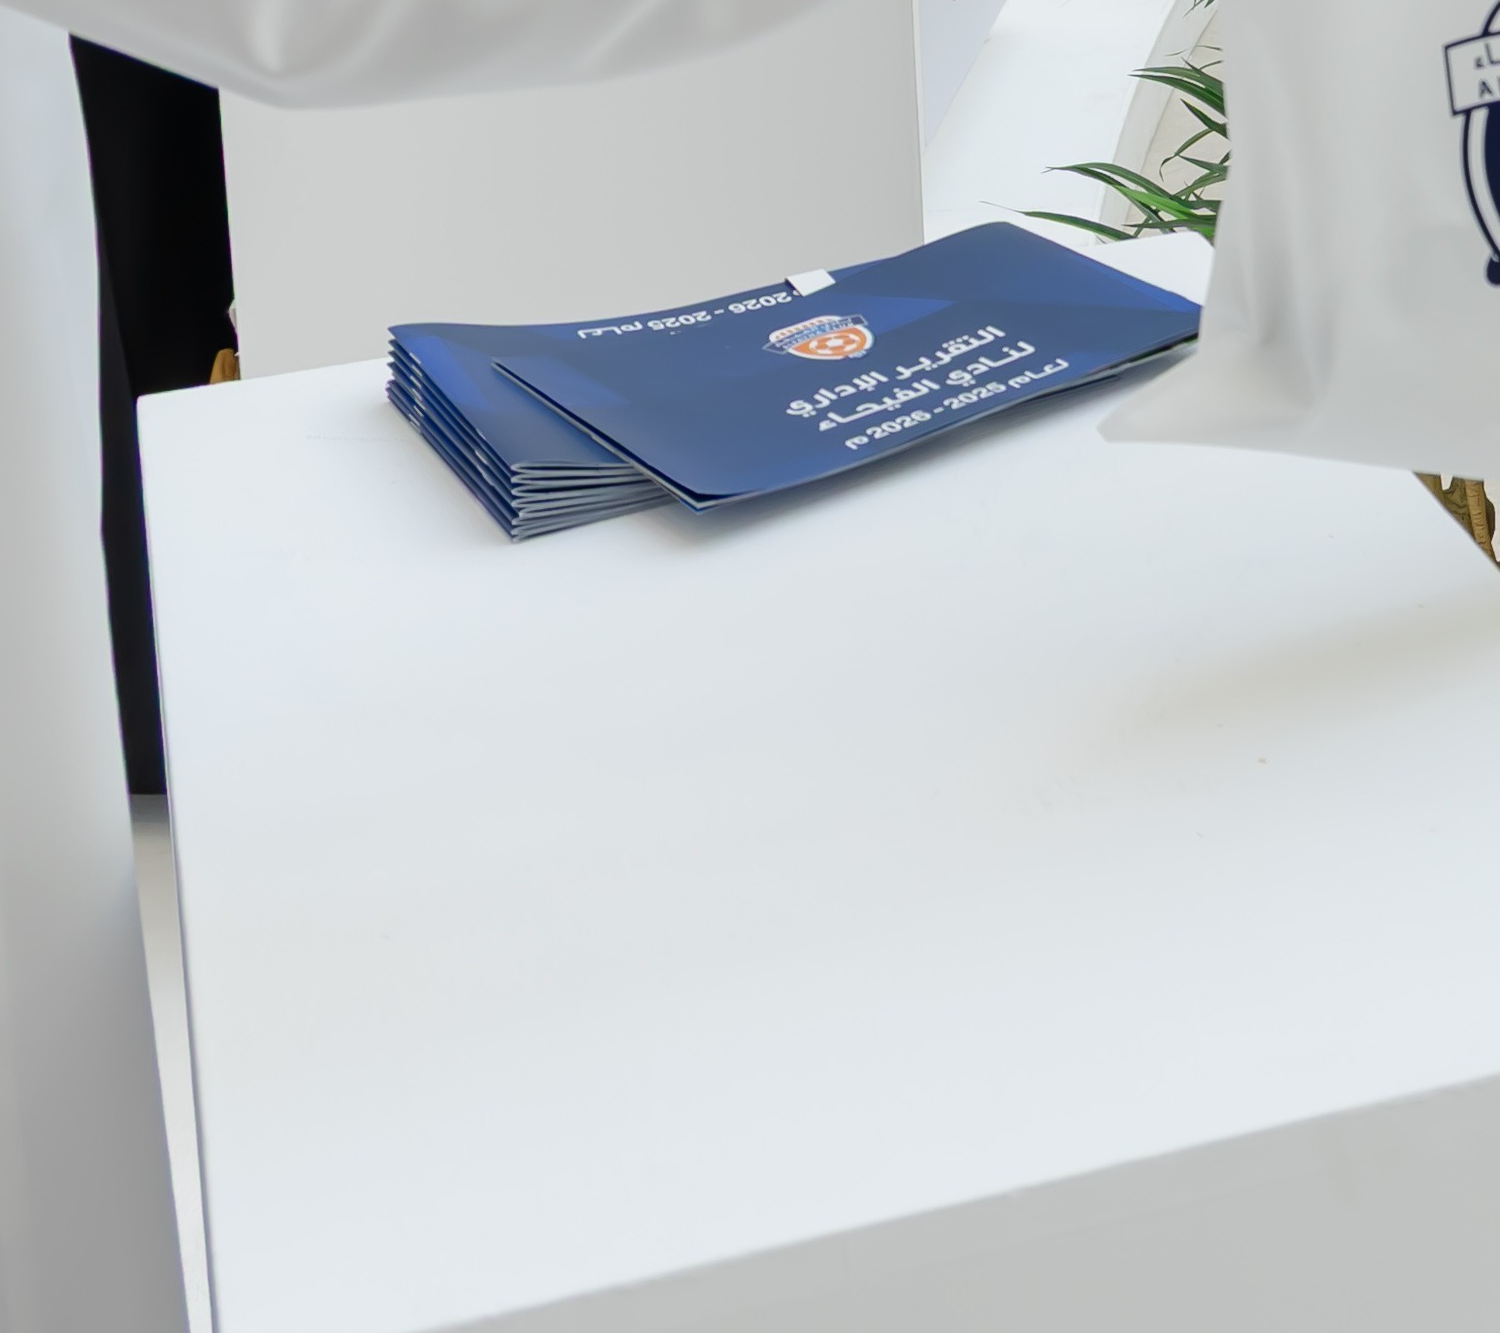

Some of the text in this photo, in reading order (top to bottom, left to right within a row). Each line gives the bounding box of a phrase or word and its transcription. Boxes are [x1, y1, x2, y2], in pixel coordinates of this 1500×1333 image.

[577, 320, 643, 339] لعام
[647, 310, 712, 331] 2025
[728, 291, 792, 314] 2026
[895, 324, 1006, 381] التقرير
[1007, 357, 1070, 389] لعام
[786, 370, 889, 418] الإداري
[818, 340, 1036, 432] لنادي الفيحاء
[943, 381, 1007, 410] 2025
[866, 409, 932, 440] 2026
